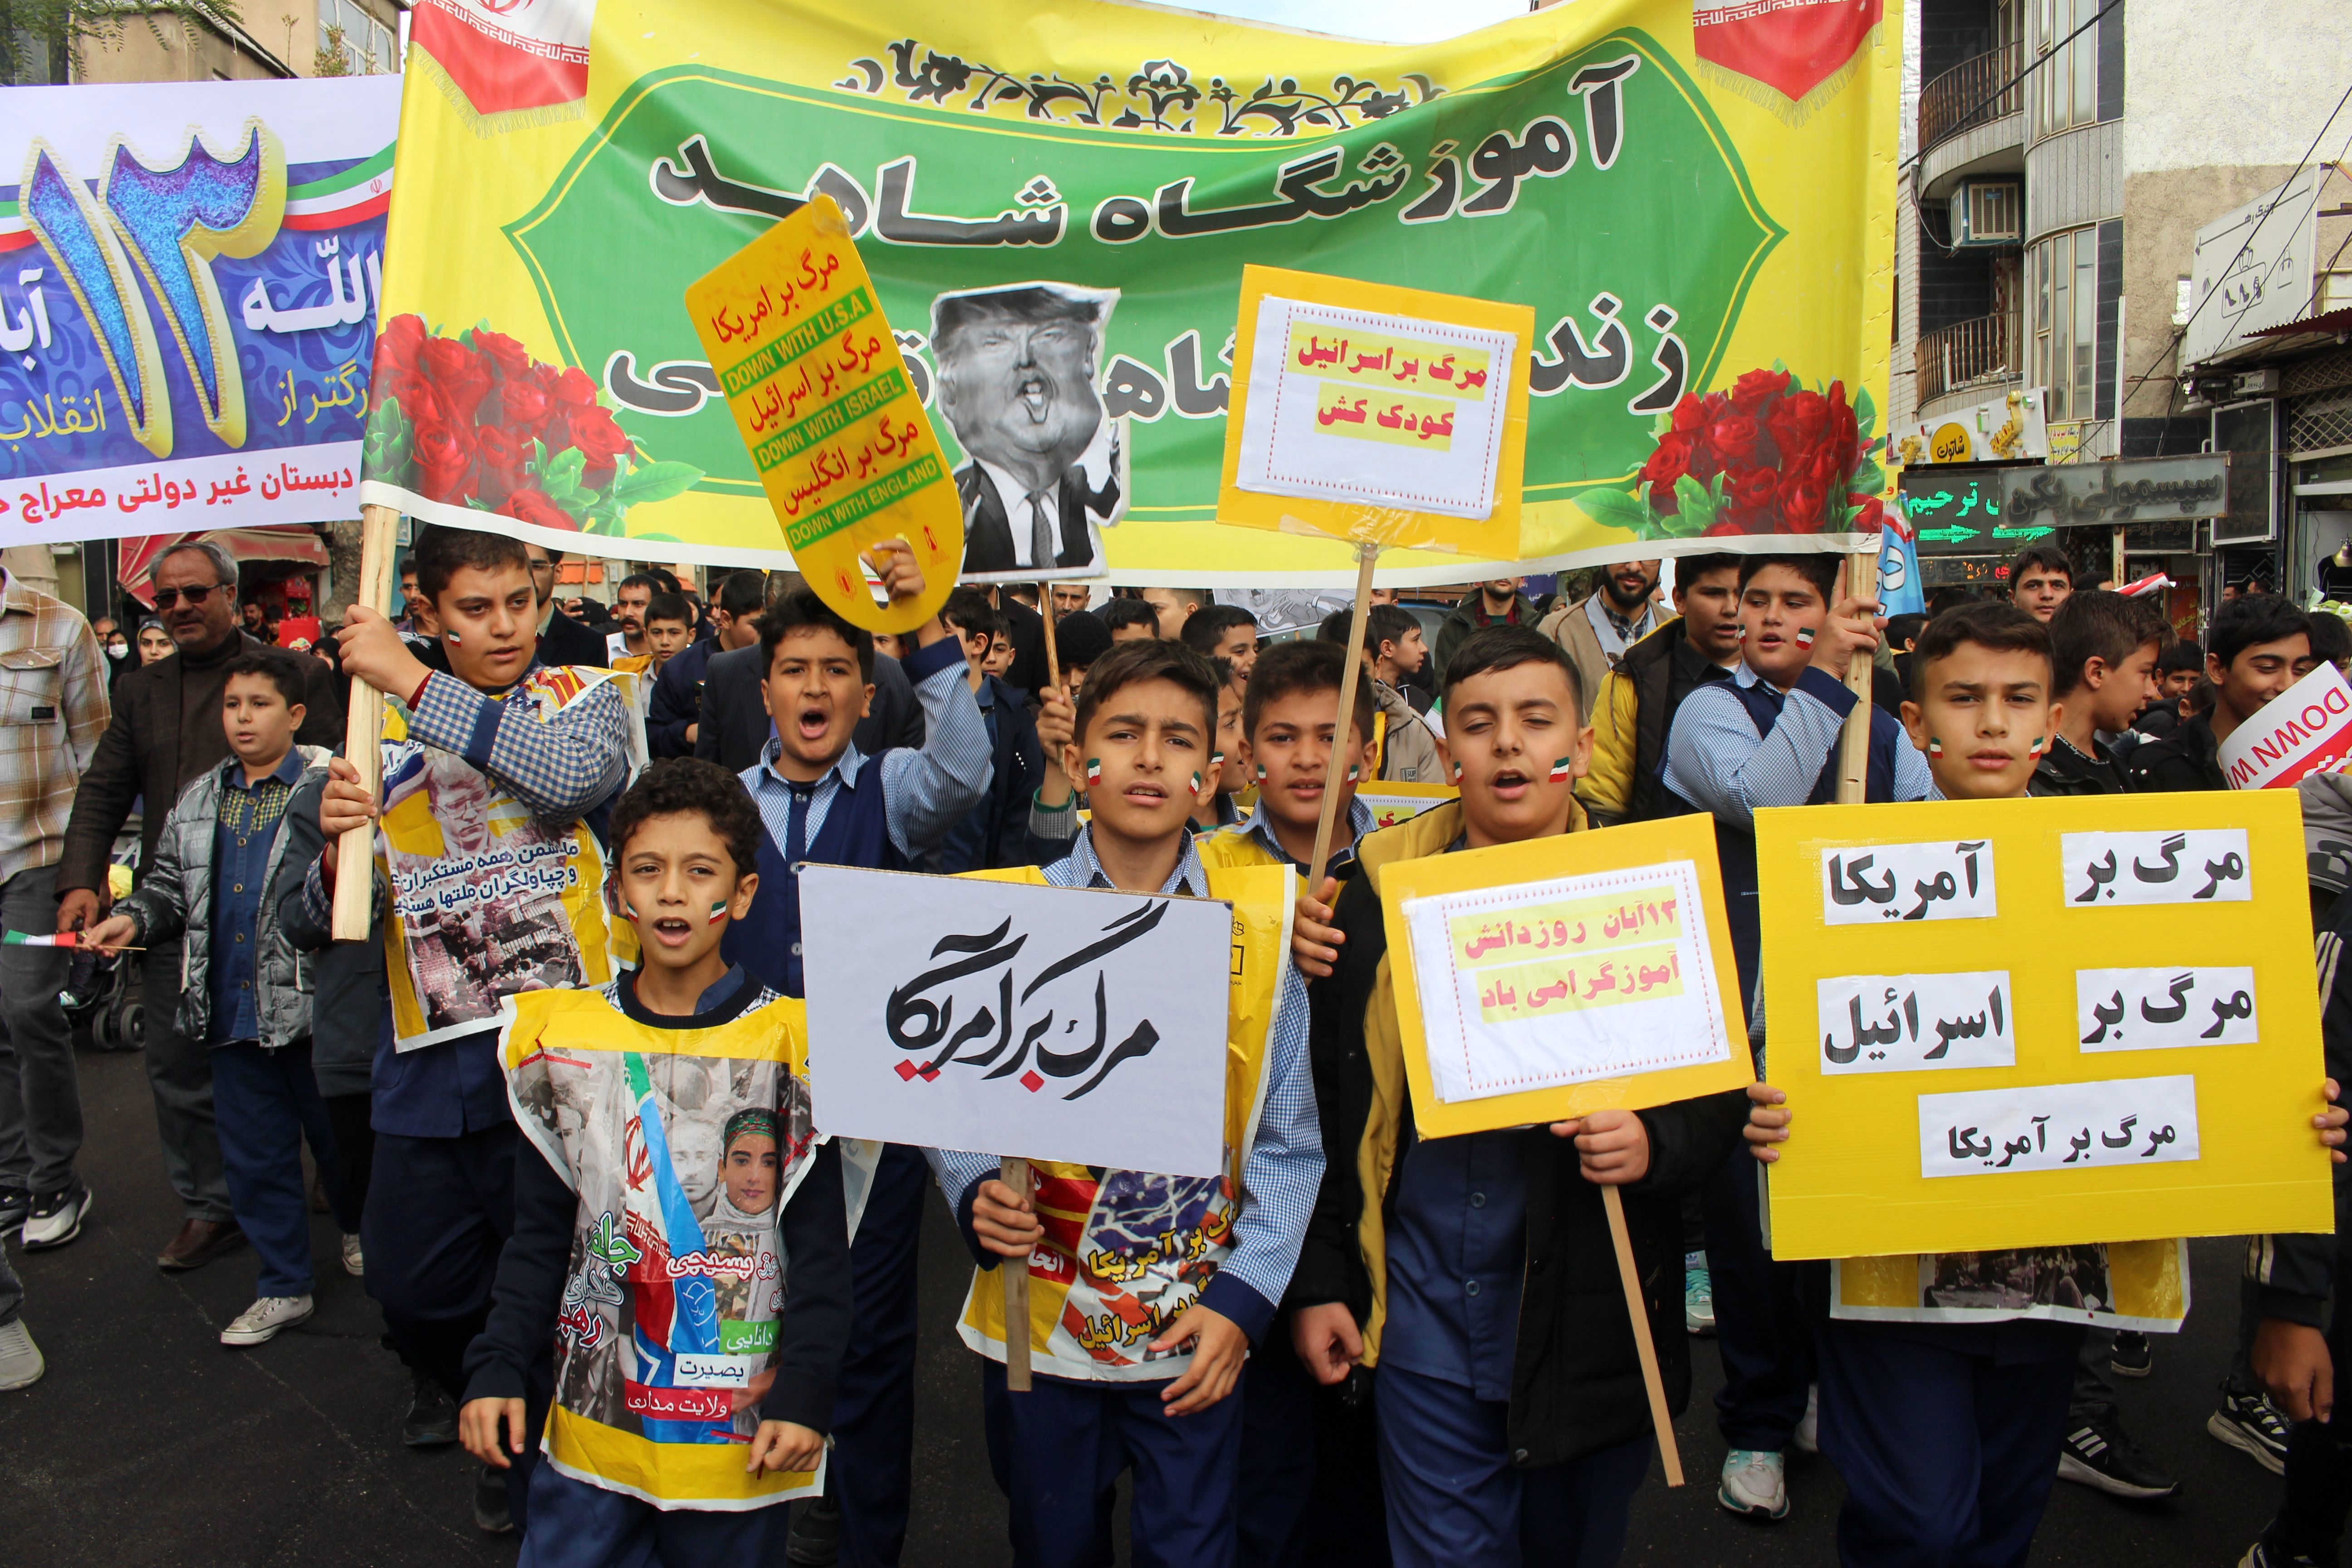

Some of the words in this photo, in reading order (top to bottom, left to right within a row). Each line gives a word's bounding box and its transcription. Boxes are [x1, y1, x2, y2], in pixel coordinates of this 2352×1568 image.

[796, 247, 839, 292] مرگ
[0, 268, 51, 371] آبا
[711, 285, 773, 344] امریکا
[780, 285, 800, 316] بر
[726, 349, 776, 393] DOWN
[775, 323, 818, 362] WITH
[821, 295, 867, 335] U.S.A
[837, 329, 881, 374] مرگ
[1298, 336, 1394, 374] اسرائیل
[2187, 344, 2216, 359] RAHA
[820, 363, 840, 397] بر
[1393, 356, 1420, 386] بر
[1428, 353, 1488, 390] مرگ
[278, 369, 297, 426] از
[750, 365, 812, 433] اسرائیل
[1318, 396, 1368, 426] کش
[0, 389, 107, 453] انقلاب
[757, 429, 804, 468] DOWN
[804, 405, 843, 443] WITH
[846, 375, 902, 415] ISRAEL
[875, 414, 918, 458] مرگ
[1377, 404, 1456, 440] کودک
[260, 463, 353, 503] دبستان
[784, 445, 850, 515] انگلیس
[858, 444, 877, 479] بر
[20, 482, 107, 524] معراج
[118, 474, 197, 513] دولتی
[206, 466, 250, 506] غیر
[789, 510, 831, 545] DOWN
[831, 492, 868, 525] WITH
[871, 458, 937, 505] ENGLAND
[2251, 686, 2350, 768] DOWN
[2227, 758, 2259, 790] WI
[478, 851, 514, 869] همه
[518, 845, 564, 864] شمن
[569, 867, 577, 883] و
[2074, 848, 2118, 903] بر
[2132, 833, 2244, 901] مرگ
[1828, 841, 1986, 921] آمریکا
[1465, 920, 1532, 960] دانش
[1536, 919, 1587, 951] روز
[1527, 960, 1621, 1008] گرامی
[1620, 951, 1680, 996] آموز
[1021, 900, 1171, 1102] مرگ
[1482, 980, 1518, 1012] باد
[2082, 989, 2124, 1044] بر
[2141, 971, 2253, 1039] مرگ
[1824, 984, 2005, 1064] اسرائیل
[980, 1008, 1055, 1093] بر
[1948, 1114, 2051, 1167] آمریکا
[2063, 1126, 2090, 1164] بر
[2101, 1112, 2177, 1158] مرگ
[1028, 1248, 1064, 1274] اتحا
[1089, 1229, 1176, 1284] آمریکا
[1187, 1226, 1208, 1260] بر
[666, 1250, 754, 1280] بسیجی
[556, 1302, 603, 1348] رهب
[727, 1325, 773, 1351] دانایی
[1078, 1302, 1161, 1351] اسرائیل
[680, 1358, 744, 1380] بصیرت
[627, 1392, 674, 1412] مداری
[679, 1395, 728, 1416] ولایت
